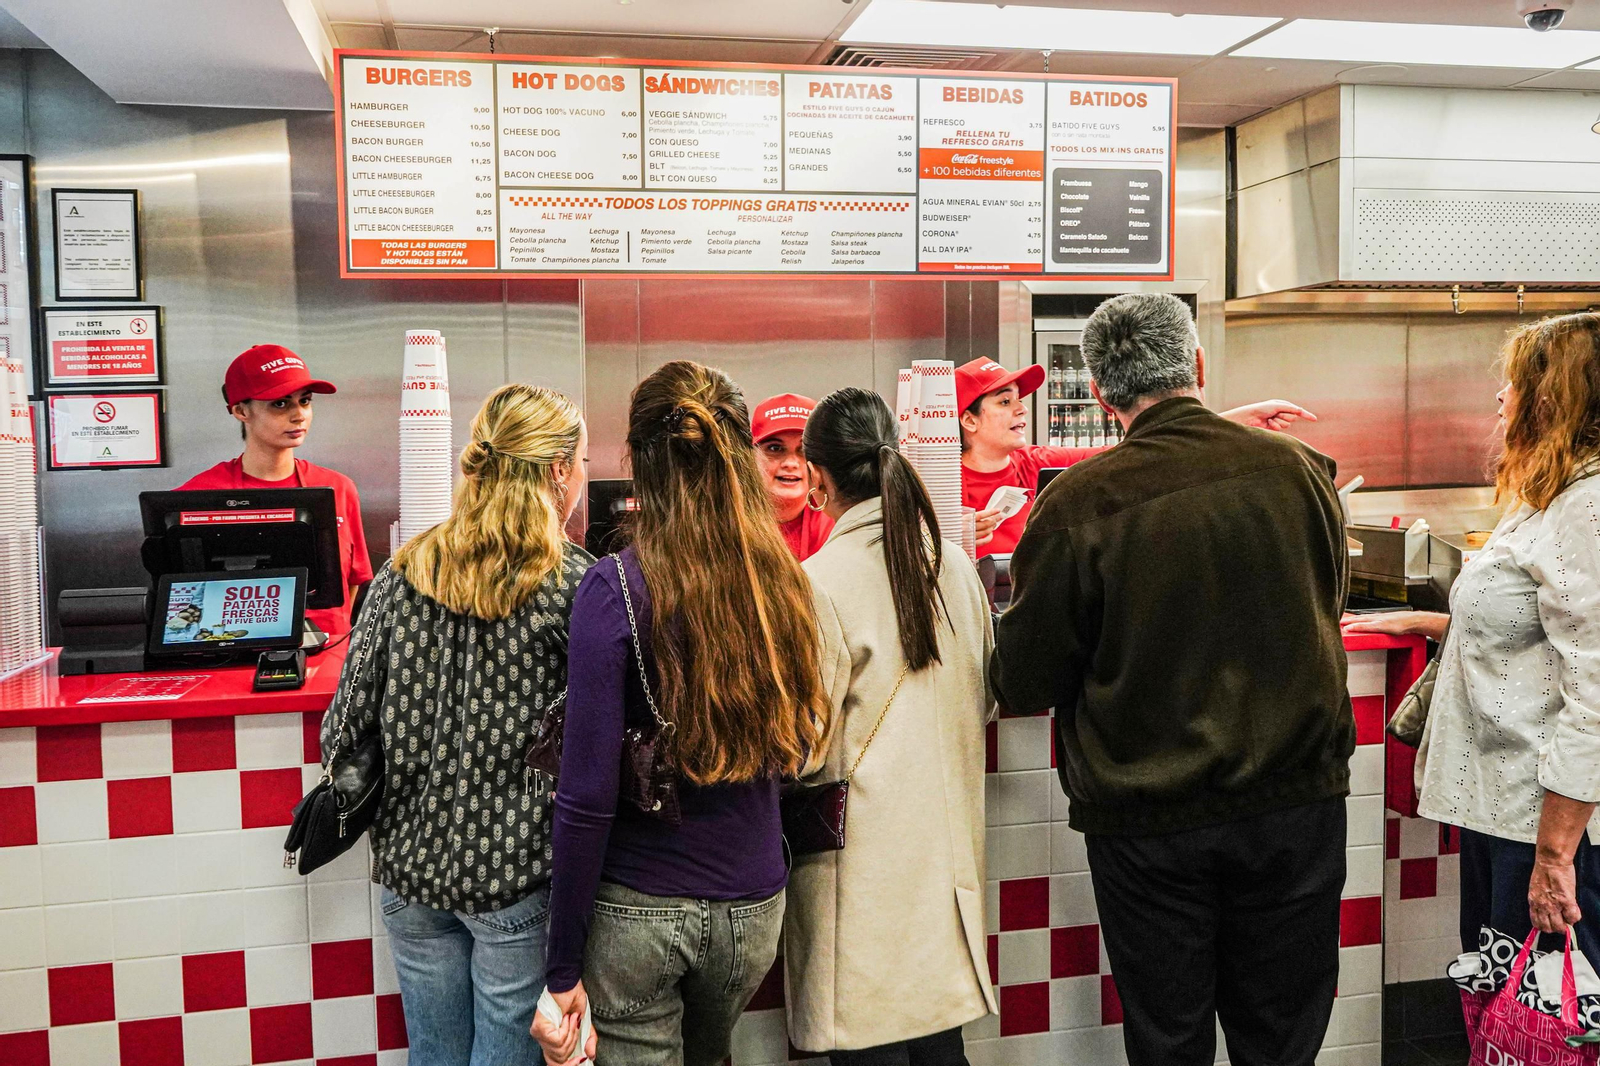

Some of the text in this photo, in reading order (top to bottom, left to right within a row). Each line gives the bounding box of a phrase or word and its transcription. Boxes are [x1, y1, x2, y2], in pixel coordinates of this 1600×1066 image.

[366, 67, 472, 87] BURGERS
[513, 72, 625, 92] HOT DOGS
[645, 73, 779, 96] SÁNDWICHES
[809, 82, 892, 100] PATATAS
[943, 87, 1024, 104] BEBIDAS
[1070, 91, 1147, 108] BATIDOS
[350, 103, 409, 111] HAMBURGER
[351, 120, 425, 129] CHEESEBURGER
[924, 118, 965, 126] REFRESCO
[503, 128, 538, 136] CHEESE
[789, 130, 833, 139] PEQUEÑAS
[956, 130, 995, 138] RELLENA
[386, 138, 423, 146] BURGER
[942, 138, 988, 146] REFRESCO
[353, 172, 375, 180] LITTLE
[933, 166, 950, 175] 100
[953, 167, 991, 176] bebidas
[994, 167, 1041, 177] diferentes
[378, 190, 435, 198] CHEESEBURGER
[605, 197, 817, 211] TODOS LOS TOPPINGS GRATIS
[405, 207, 434, 215] BURGER
[402, 224, 454, 232] CHEESEBURGER
[708, 229, 736, 237] Lechuga
[436, 249, 463, 257] ESTÁN
[261, 359, 284, 371] FIVE
[403, 382, 426, 390] GUYS
[765, 407, 786, 417] FIVE
[225, 584, 281, 601] SOLO
[223, 599, 279, 610] PATATAS
[223, 608, 279, 618] FRESCAS
